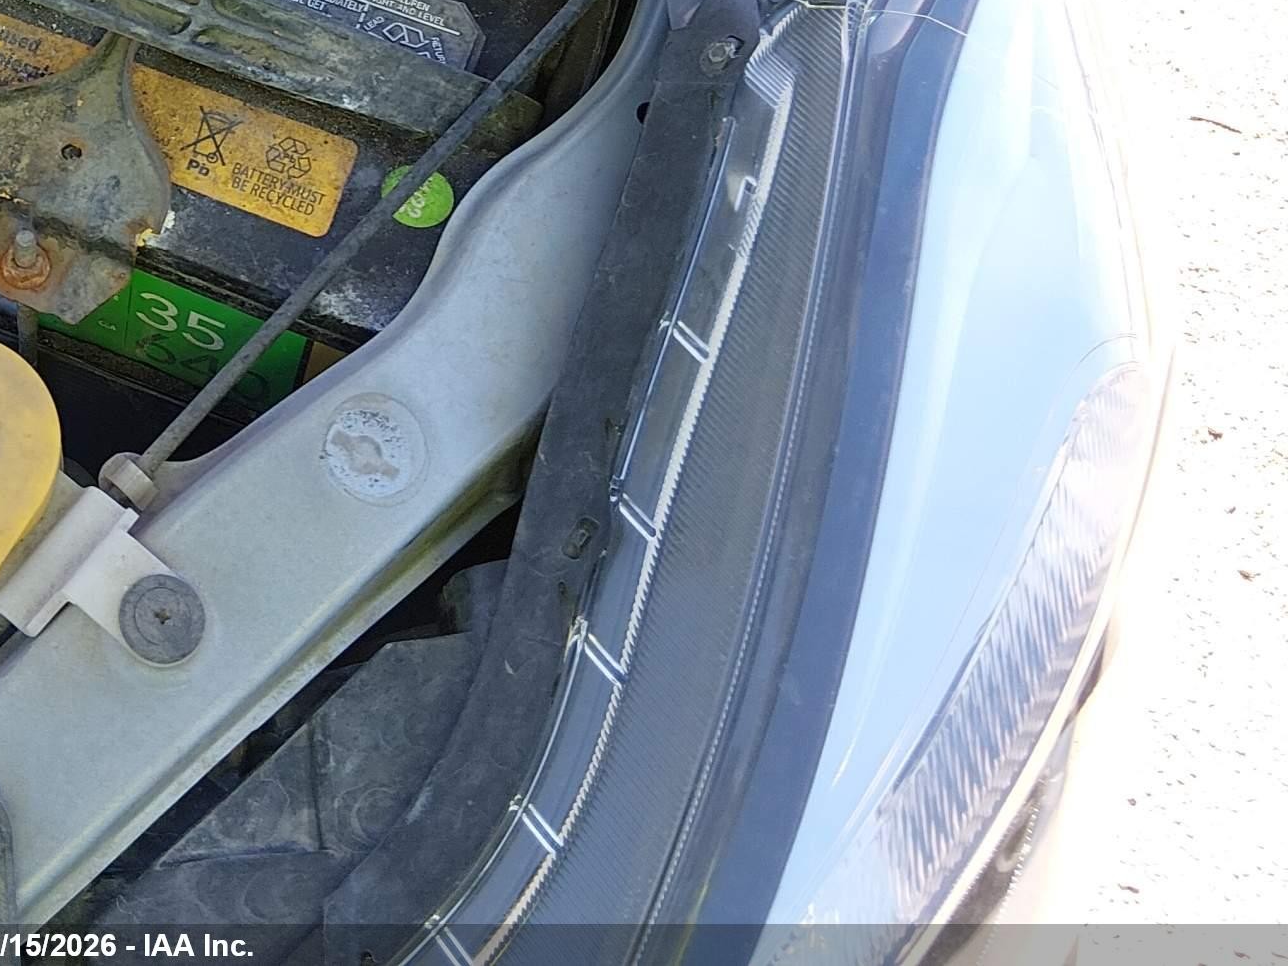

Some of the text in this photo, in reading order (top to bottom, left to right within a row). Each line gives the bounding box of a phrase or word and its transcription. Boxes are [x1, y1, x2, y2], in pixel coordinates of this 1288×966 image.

[396, 2, 417, 16] AND
[417, 9, 446, 27] LEVEL
[186, 159, 210, 176] Pb
[232, 162, 326, 205] BATTERY MUST
[231, 178, 315, 216] BE RECYCLED
[135, 292, 226, 351] 35
